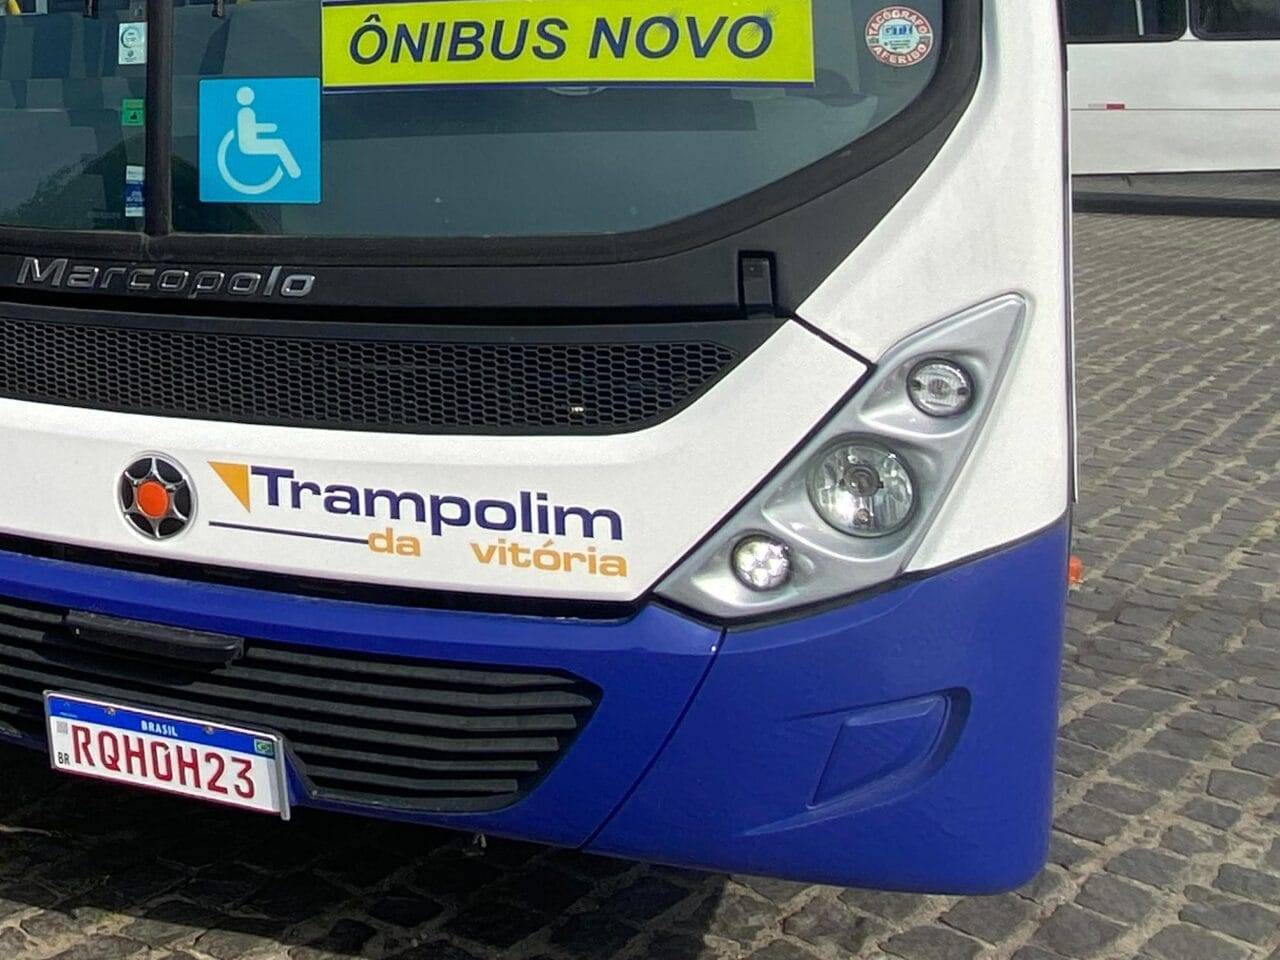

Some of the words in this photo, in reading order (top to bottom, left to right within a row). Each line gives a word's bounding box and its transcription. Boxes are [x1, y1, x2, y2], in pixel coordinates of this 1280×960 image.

[348, 13, 569, 65] ÔNIBUS
[589, 14, 774, 60] NOVO
[15, 256, 316, 299] Marcopolo
[250, 464, 624, 541] Trampolim
[366, 526, 422, 559] da
[469, 538, 628, 578] vitória
[140, 720, 178, 737] BRASIL
[57, 751, 71, 766] BR
